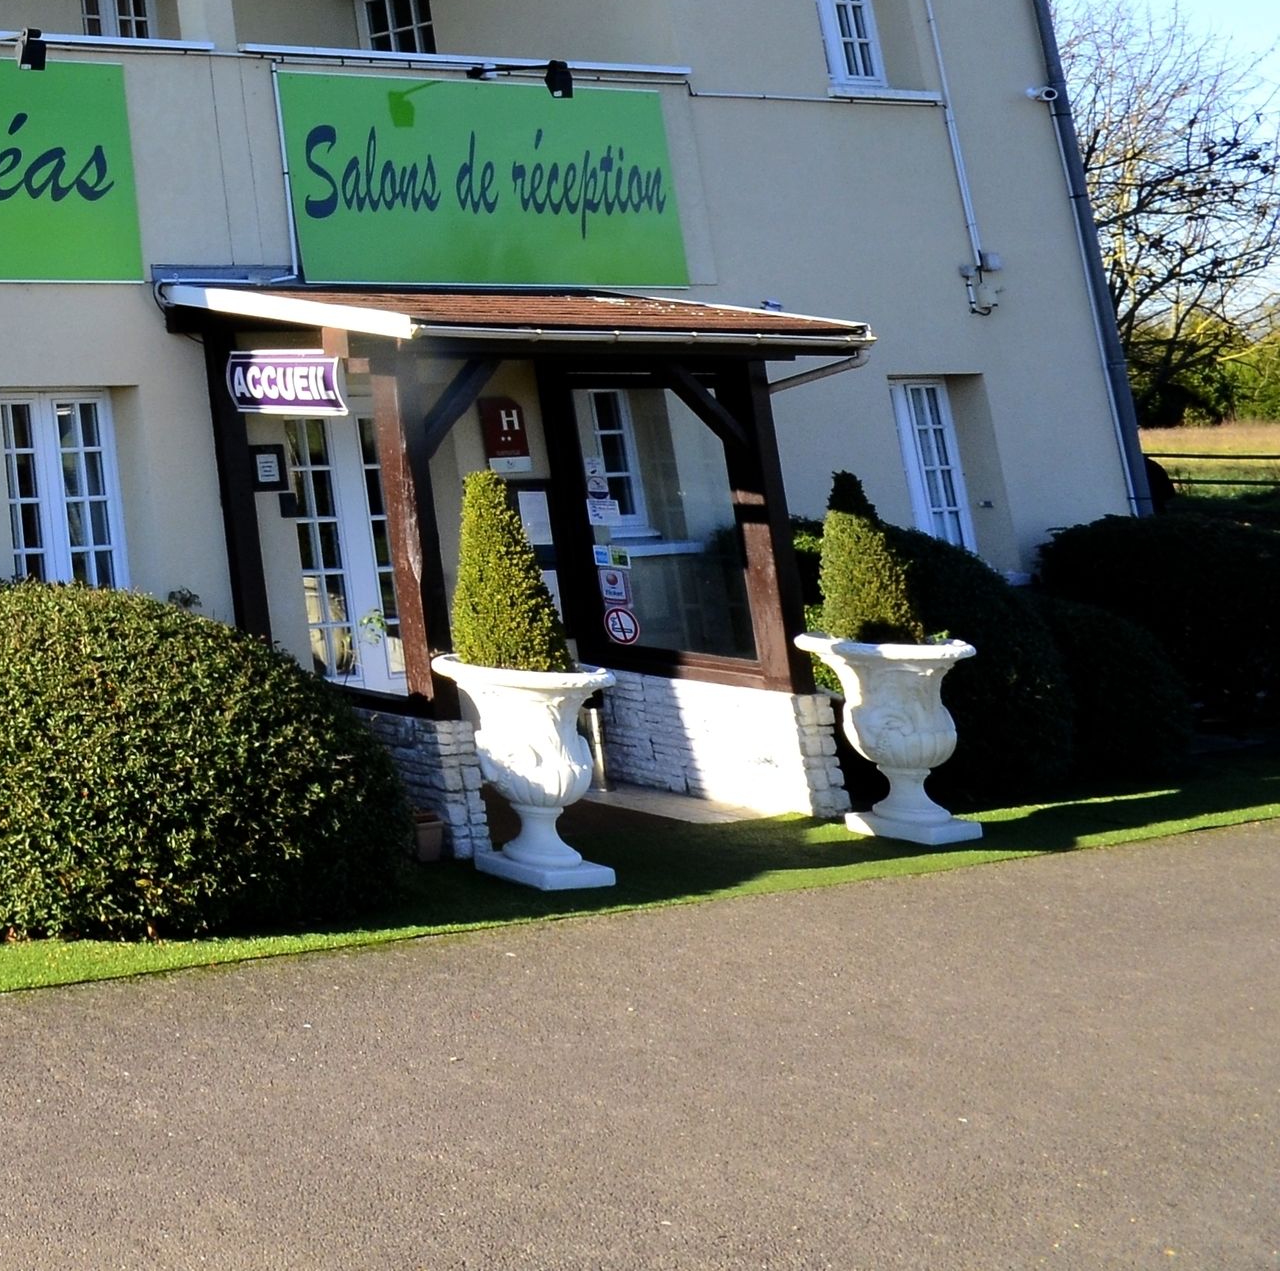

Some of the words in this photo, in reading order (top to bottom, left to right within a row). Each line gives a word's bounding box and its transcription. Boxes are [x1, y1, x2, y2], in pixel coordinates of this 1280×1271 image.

[305, 125, 441, 219] Salons
[456, 130, 499, 214] de
[512, 129, 666, 240] réception
[234, 365, 336, 400] ACCUEIL
[501, 410, 519, 430] H
